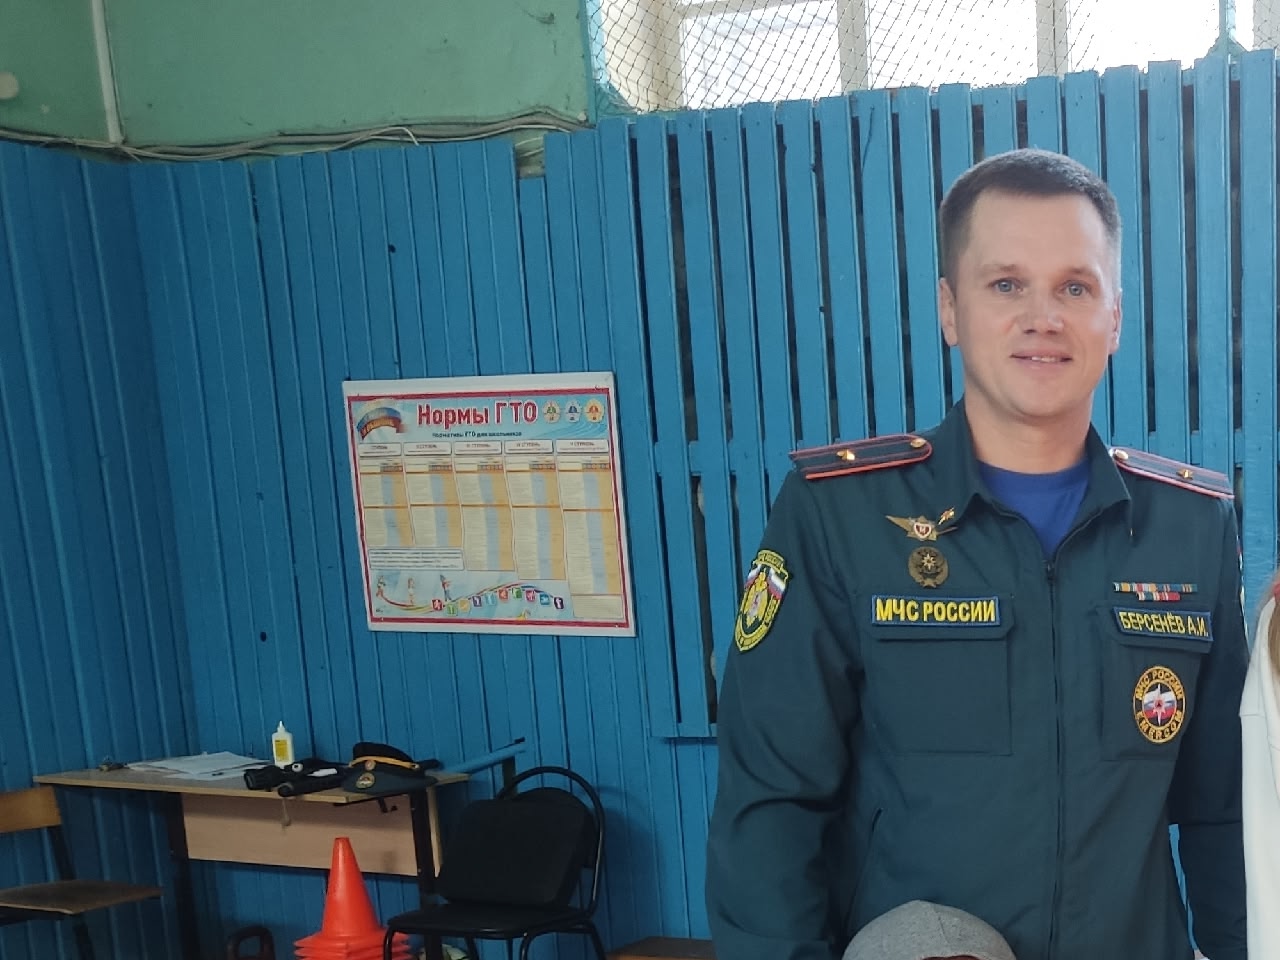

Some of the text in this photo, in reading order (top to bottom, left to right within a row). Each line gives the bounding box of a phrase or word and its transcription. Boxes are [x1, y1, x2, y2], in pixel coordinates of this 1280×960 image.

[418, 401, 538, 430] Нормы ГТО
[876, 598, 996, 622] МЧС РОССИИ
[1119, 611, 1209, 637] БЕРСЕНЁВ А.И.
[1135, 669, 1183, 700] МЧС РОССИИ
[1136, 710, 1183, 740] EMERCOM
